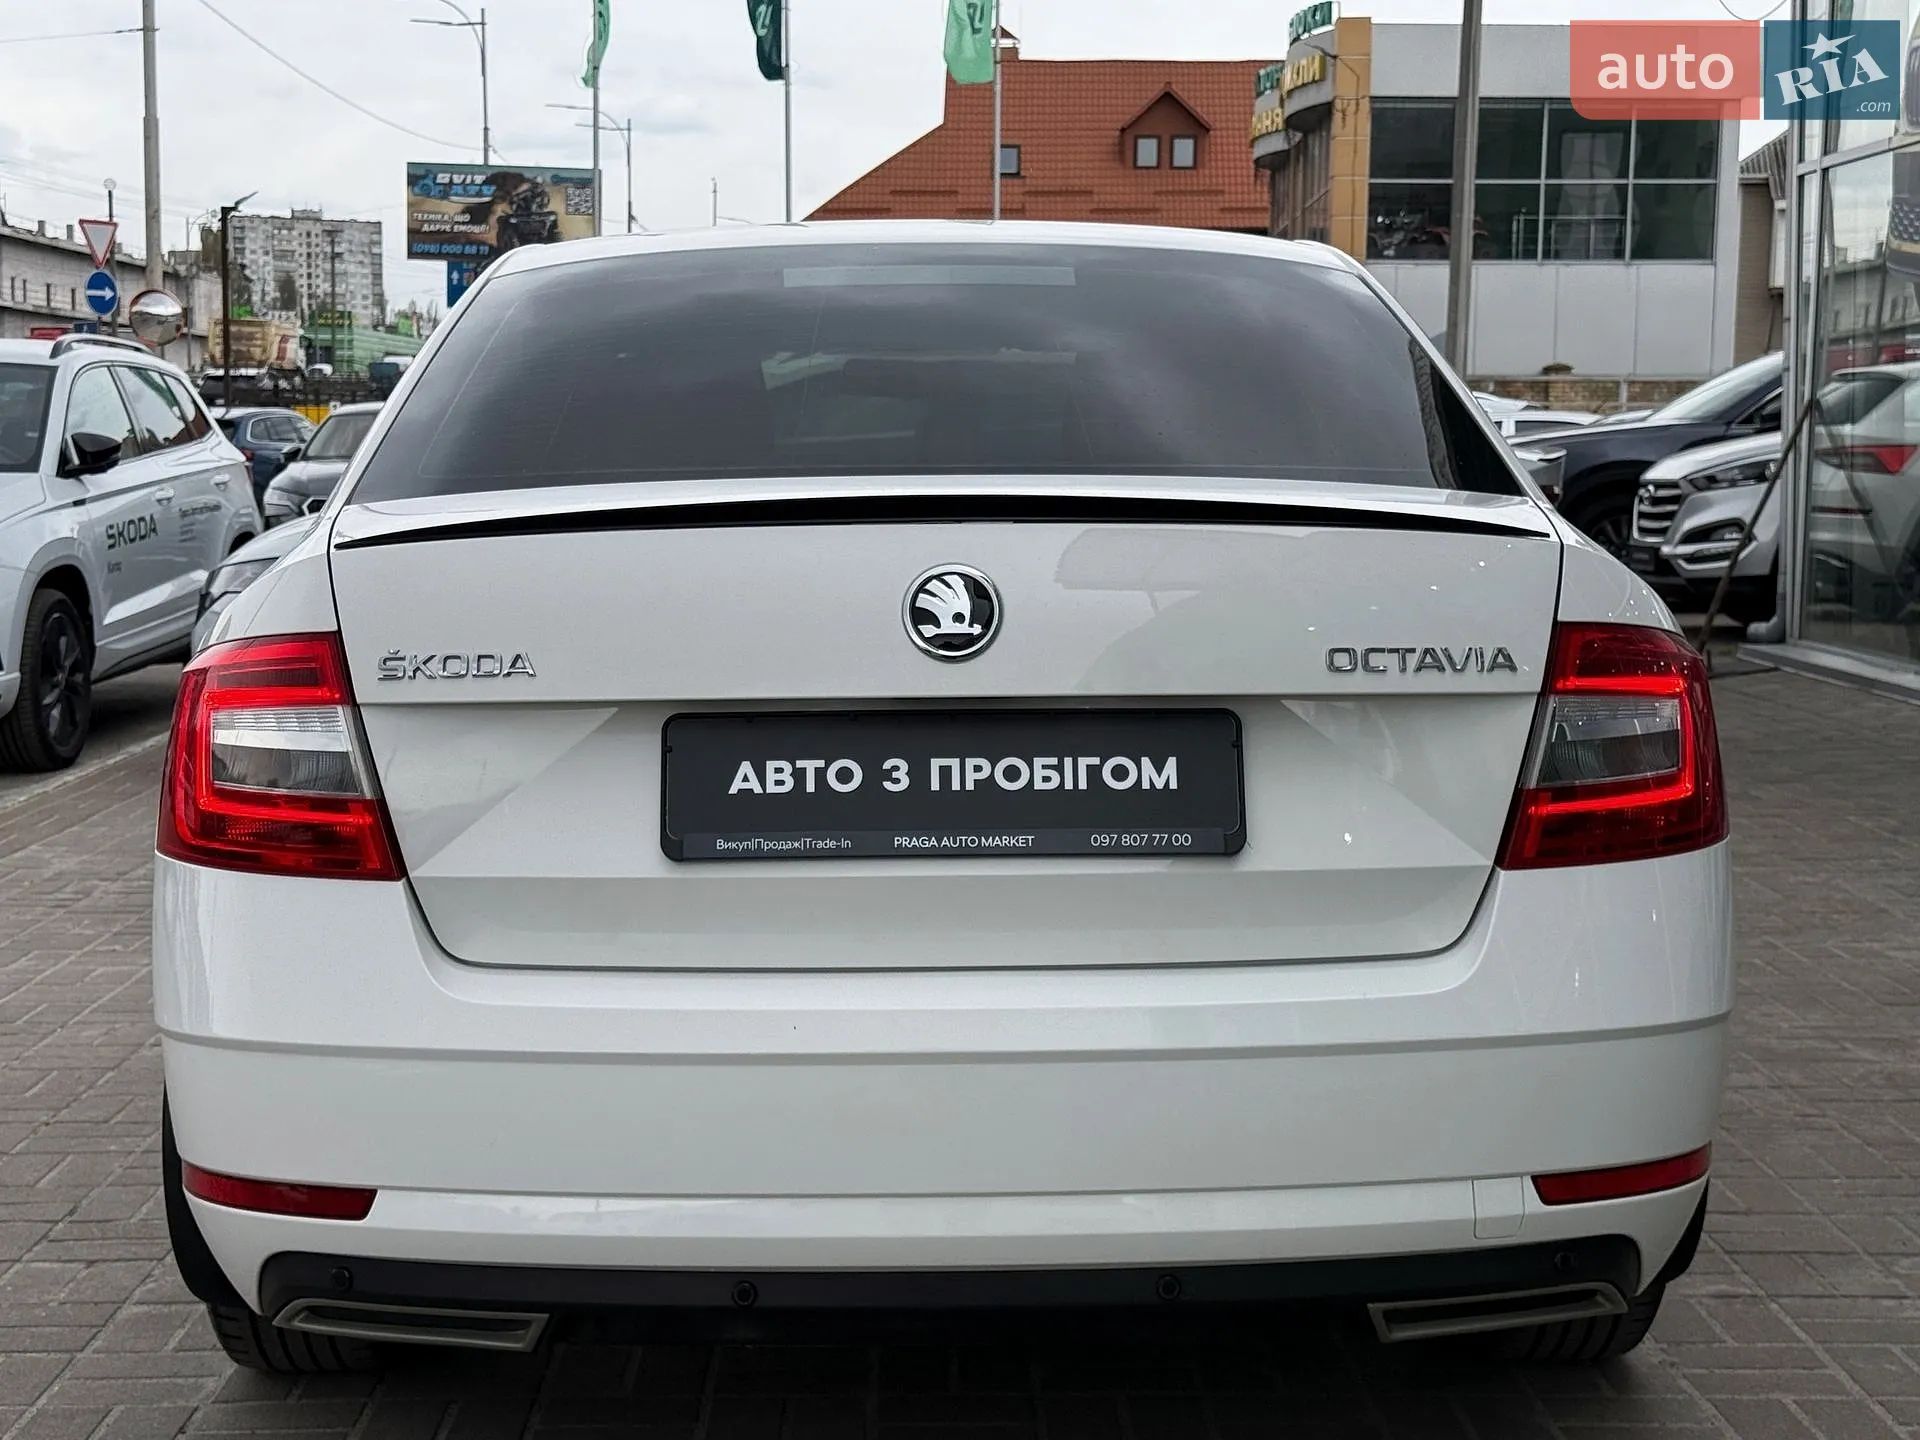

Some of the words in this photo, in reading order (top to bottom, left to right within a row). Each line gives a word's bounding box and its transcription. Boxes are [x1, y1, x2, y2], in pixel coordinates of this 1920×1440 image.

[377, 649, 537, 681] ŠKODA
[1325, 647, 1518, 673] OCTAVIA
[728, 758, 863, 794] АВТО
[881, 758, 910, 792] З
[930, 756, 1178, 791] ПРОБІГОМ
[894, 836, 938, 848] PRAGA
[940, 836, 978, 848] AUTO
[981, 835, 1034, 847] MARKET
[1090, 834, 1117, 846] 097
[1121, 834, 1148, 846] 807
[1152, 834, 1168, 846] 77
[1172, 833, 1192, 846] 00
